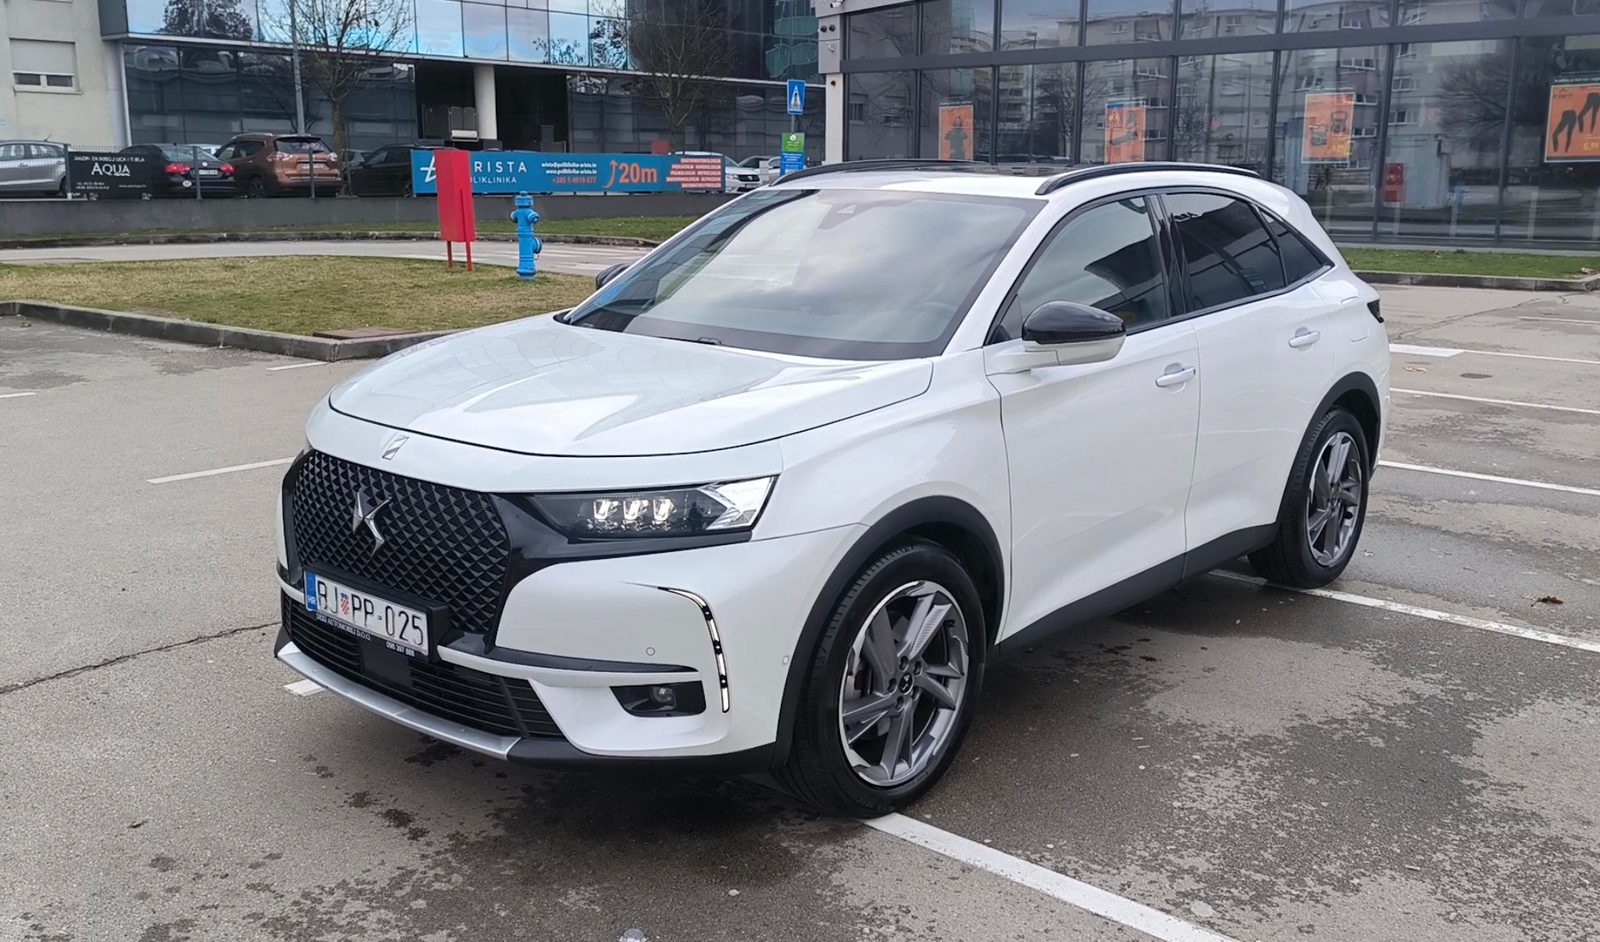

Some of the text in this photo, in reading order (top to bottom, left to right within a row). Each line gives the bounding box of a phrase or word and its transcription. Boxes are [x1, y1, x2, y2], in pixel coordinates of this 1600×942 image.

[91, 162, 130, 176] AQUA
[474, 161, 527, 173] RISTA
[619, 162, 657, 183] 20m
[351, 594, 424, 645] PP-025
